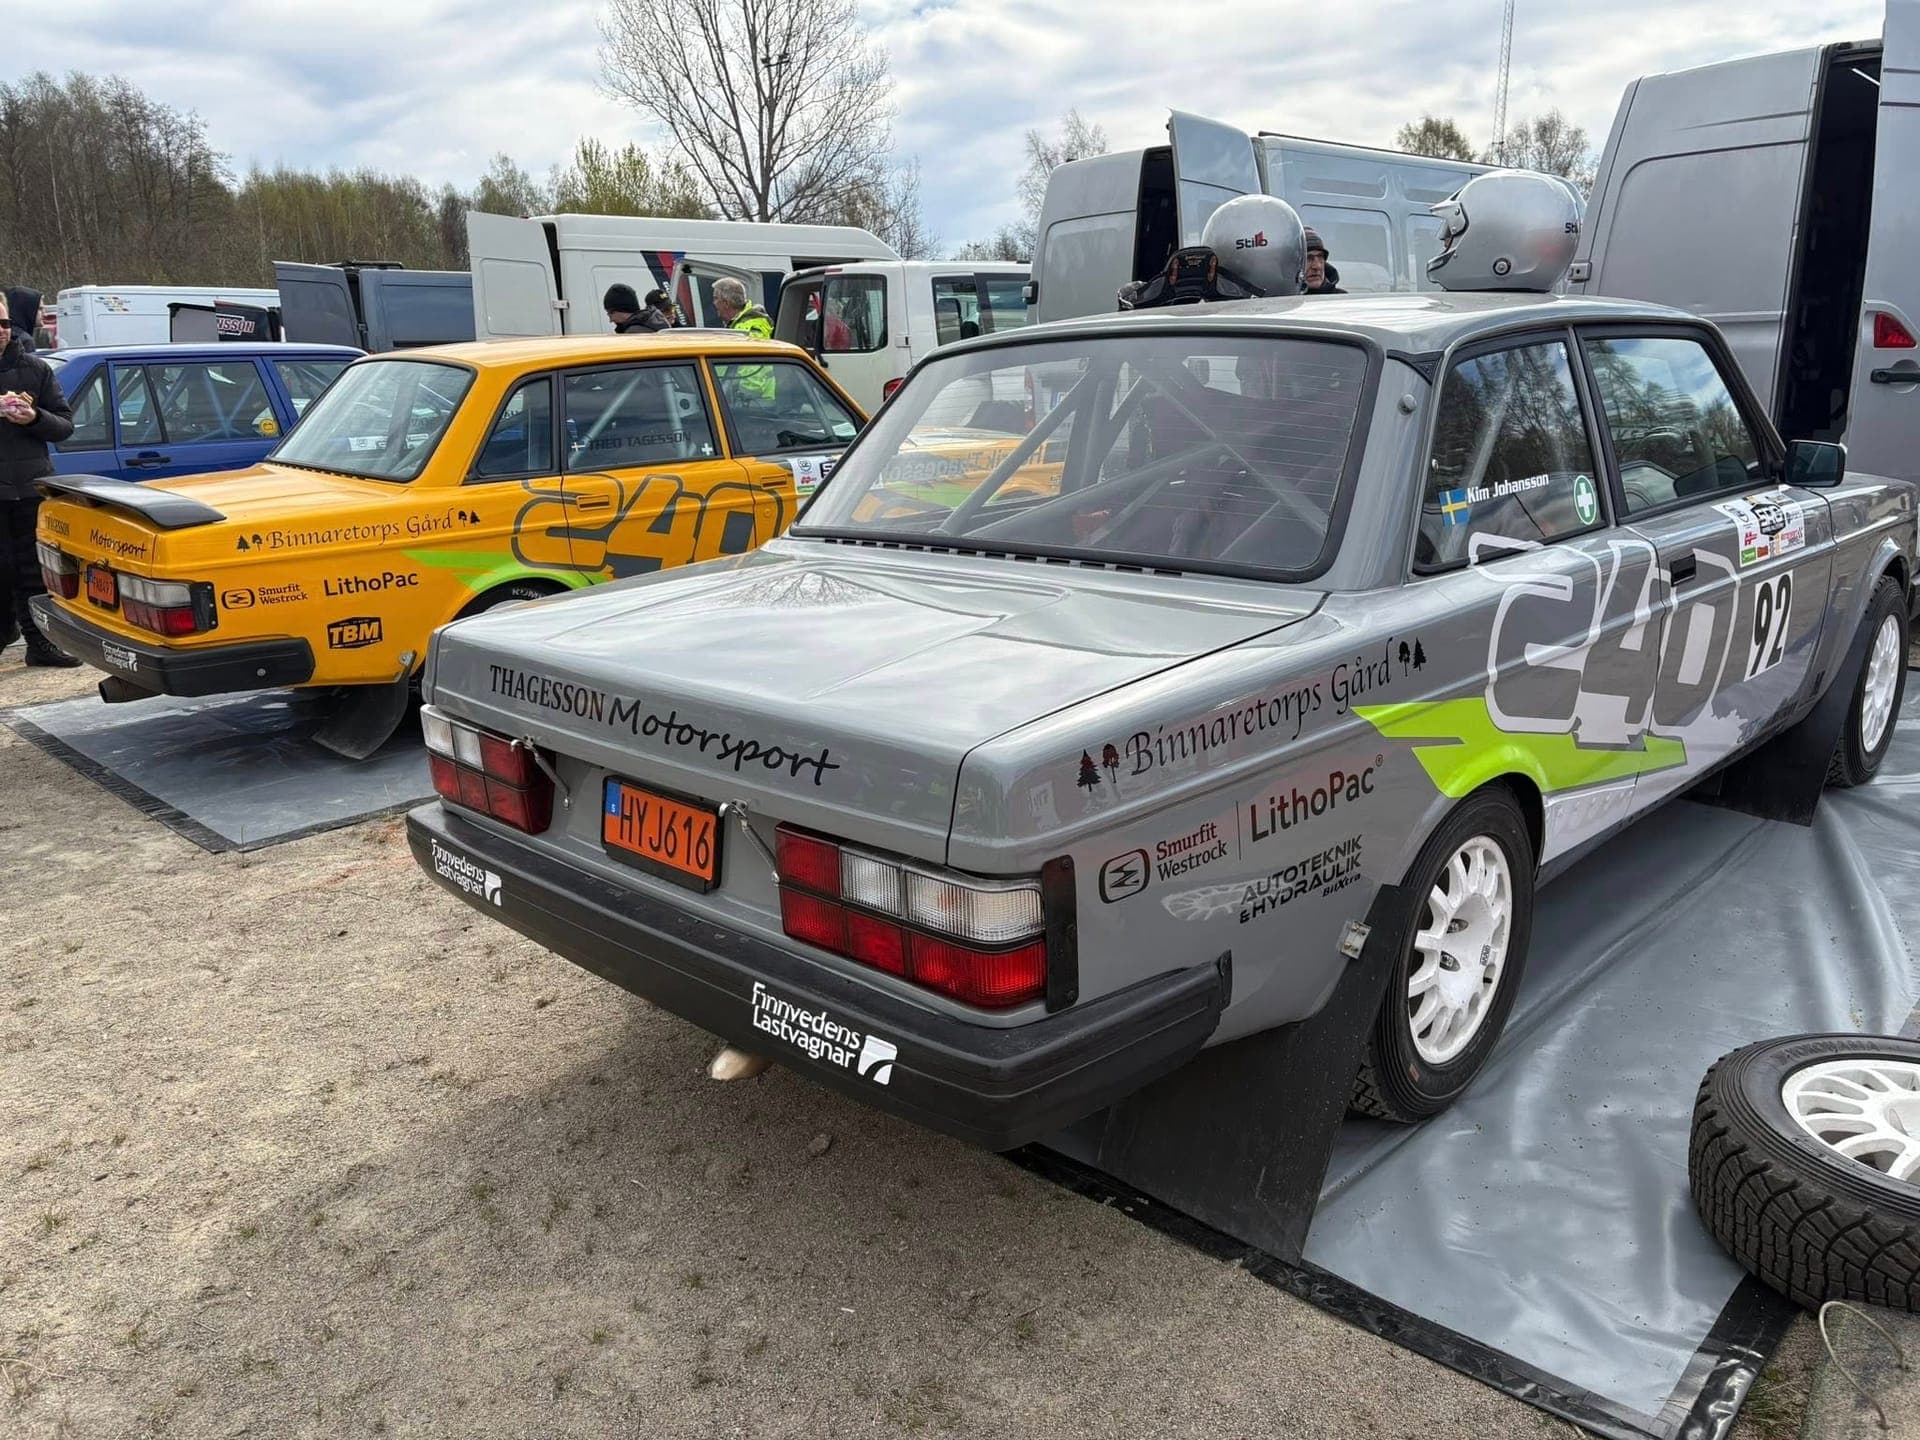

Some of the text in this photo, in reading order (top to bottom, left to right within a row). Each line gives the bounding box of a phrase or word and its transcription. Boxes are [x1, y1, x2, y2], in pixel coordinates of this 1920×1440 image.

[1236, 231, 1268, 249] Stilo
[625, 431, 692, 448] TAGESSON
[1467, 474, 1549, 503] Kim Johansson
[89, 529, 147, 559] Motorsport
[266, 508, 455, 549] Binnaretorps Gård
[258, 583, 301, 597] Smurfit
[260, 591, 308, 605] Westrock
[324, 571, 419, 597] LithoPac
[329, 620, 380, 645] TBM
[1467, 531, 1741, 747] 240
[1748, 572, 1792, 677] 92
[489, 664, 841, 786] THAGESSON Motorsport
[1125, 637, 1394, 776] Binnaretorps Gård
[619, 793, 711, 870] HYJ616
[1156, 821, 1218, 861] Smurfit
[431, 837, 485, 882] Finnvedens
[434, 855, 483, 897] Lastvagnar
[1157, 839, 1228, 882] Westrock
[1241, 834, 1362, 905] AUTOTEKNIK
[1322, 873, 1361, 898] BilXtra
[752, 980, 861, 1050] Finnvedens
[753, 1004, 857, 1068] Lastvagnar
